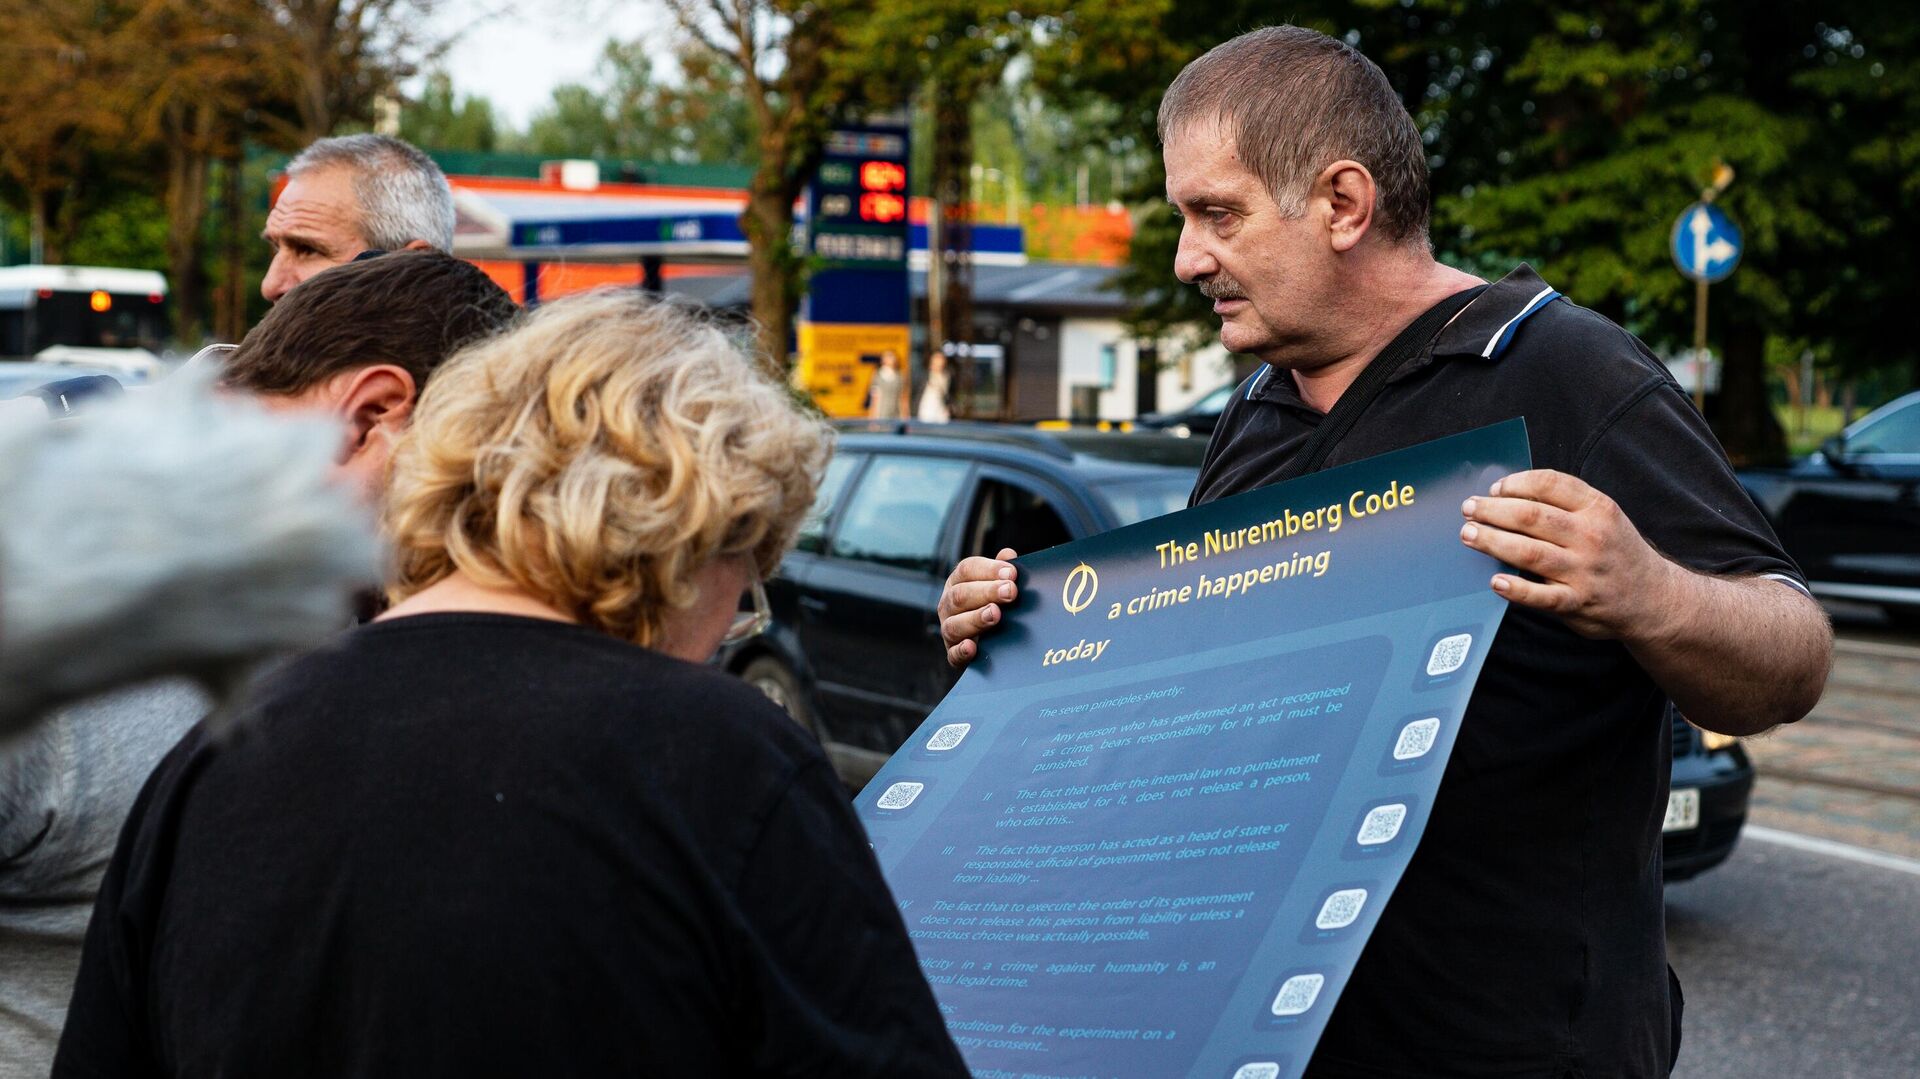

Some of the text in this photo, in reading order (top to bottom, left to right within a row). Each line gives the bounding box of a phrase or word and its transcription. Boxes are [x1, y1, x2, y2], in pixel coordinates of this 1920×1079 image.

[1155, 480, 1415, 569] The Nuremberg Code
[1107, 550, 1331, 620] a crime happening
[1042, 637, 1111, 667] today
[1039, 686, 1184, 719] The seven principles shortly:
[1051, 733, 1076, 743] Any
[1076, 726, 1117, 741] person
[1120, 720, 1145, 732] who
[1149, 717, 1169, 728] has
[1171, 704, 1237, 726] performed
[1238, 703, 1254, 713] an
[1258, 698, 1278, 710] act
[1281, 682, 1351, 705] recognized
[1042, 747, 1056, 757] as
[1100, 737, 1132, 750] bears
[1136, 724, 1215, 744] responsibility
[1220, 719, 1238, 731] for
[1243, 716, 1254, 727] it
[1257, 711, 1283, 725] and
[1287, 705, 1320, 719] must
[1326, 702, 1343, 713] be
[1016, 789, 1038, 799] The
[1039, 788, 1062, 799] fact
[1065, 785, 1088, 796] that
[1091, 780, 1126, 793] under
[1128, 776, 1149, 789] the
[1151, 769, 1199, 785] internal
[1200, 767, 1223, 779] law
[1225, 765, 1241, 776] no
[1243, 753, 1321, 774] punishment
[1032, 756, 1089, 774] punished.
[1005, 805, 1016, 814] is
[1021, 799, 1090, 813] established
[1093, 796, 1112, 808] for
[1135, 790, 1165, 803] does
[1171, 787, 1194, 798] not
[1200, 779, 1244, 794] release
[1249, 778, 1258, 789] a
[1264, 771, 1312, 788] person,
[995, 818, 1022, 828] who
[1023, 815, 1044, 826] did
[975, 845, 998, 855] The
[1000, 846, 1023, 855] fact
[1026, 844, 1050, 854] that
[1053, 843, 1096, 855] person
[1098, 840, 1119, 850] has
[1122, 835, 1159, 849] acted
[1160, 834, 1175, 845] as
[1176, 833, 1185, 842] a
[1187, 828, 1221, 842] head
[1222, 826, 1240, 838] of
[1239, 824, 1272, 837] state
[1274, 823, 1290, 833] or
[964, 839, 1281, 870] responsible official of government, does not release
[953, 873, 982, 883] from
[984, 872, 1031, 885] liability
[932, 900, 956, 911] The
[956, 901, 982, 911] fact
[982, 902, 1008, 912] that
[1010, 902, 1025, 912] to
[1026, 902, 1076, 912] execute
[1078, 900, 1100, 911] the
[1100, 898, 1136, 910] order
[1139, 896, 1155, 908] of
[1154, 896, 1170, 907] its
[1172, 892, 1255, 909] government
[920, 908, 1244, 929] does not release this person from liability unless a
[909, 928, 1150, 943] conscious choice was actually possible.
[956, 974, 991, 987] legal
[990, 975, 1029, 987] crime.
[961, 960, 975, 969] in
[983, 962, 993, 970] a
[1001, 961, 1039, 972] crime
[1046, 961, 1096, 975] against
[1104, 961, 1169, 974] humanity
[1177, 959, 1189, 972] is
[1198, 961, 1216, 971] an
[1007, 1022, 1030, 1035] for
[1032, 1024, 1056, 1036] the
[1059, 1028, 1137, 1039] experiment
[1142, 1030, 1162, 1040] on
[1166, 1030, 1176, 1040] a
